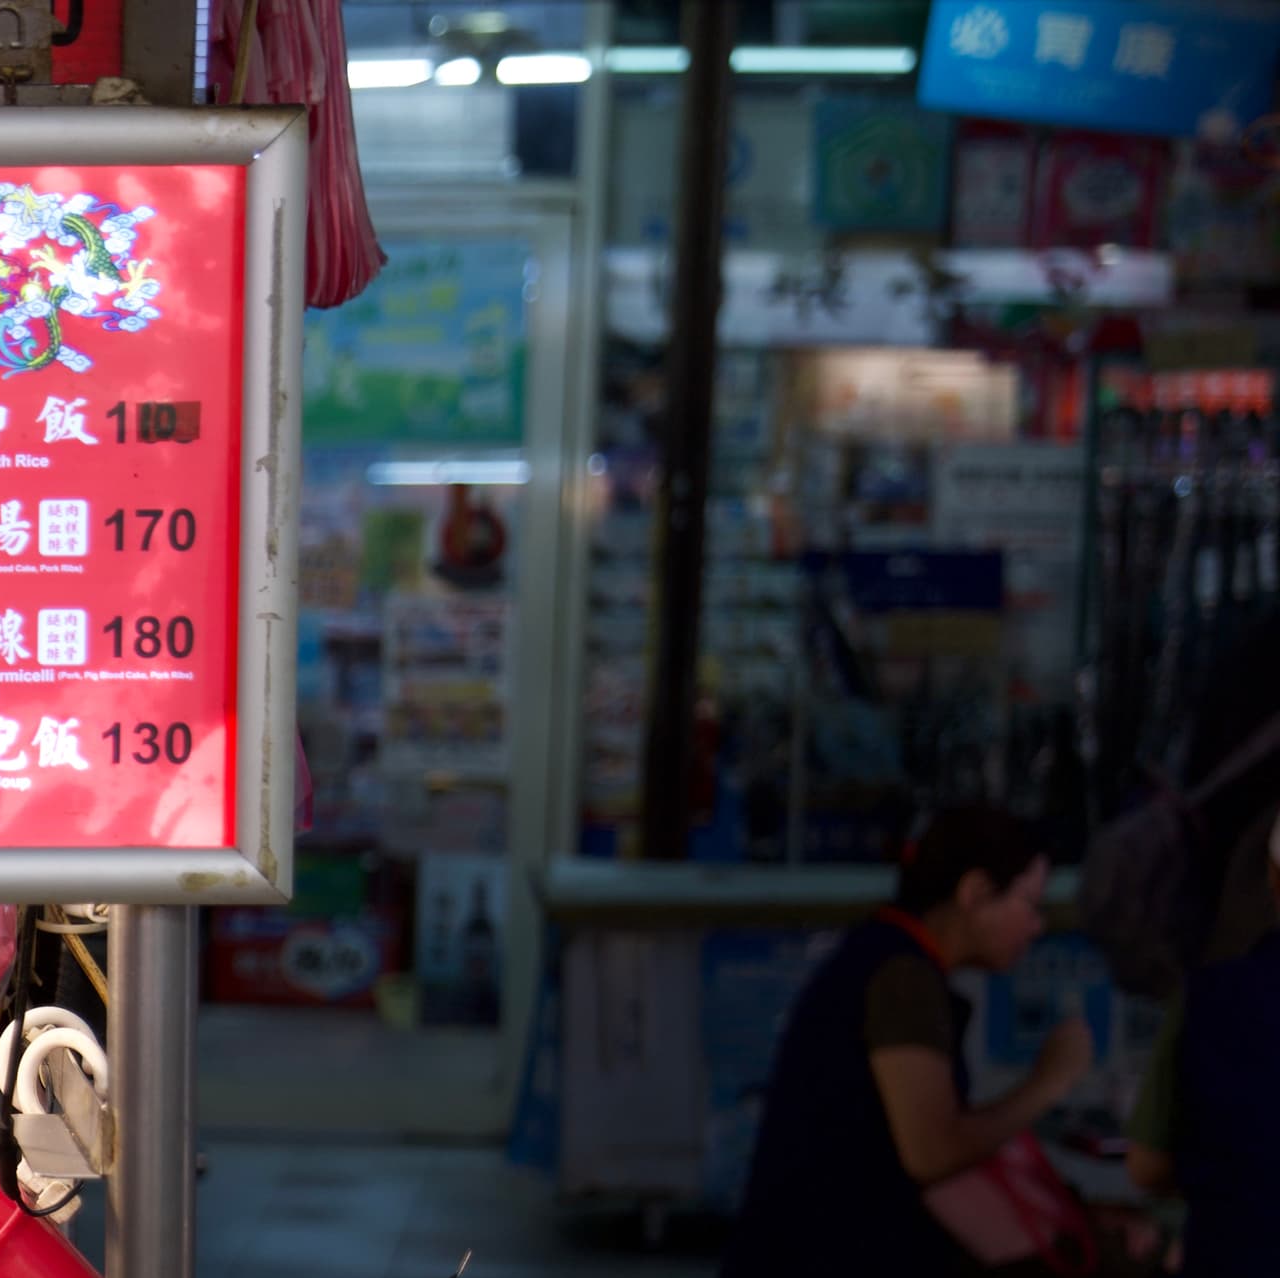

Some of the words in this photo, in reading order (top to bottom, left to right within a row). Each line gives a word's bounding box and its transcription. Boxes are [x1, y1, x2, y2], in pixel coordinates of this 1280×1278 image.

[15, 454, 49, 468] Rice
[104, 509, 196, 552] 170
[103, 615, 195, 659] 180
[101, 722, 193, 764] 130
